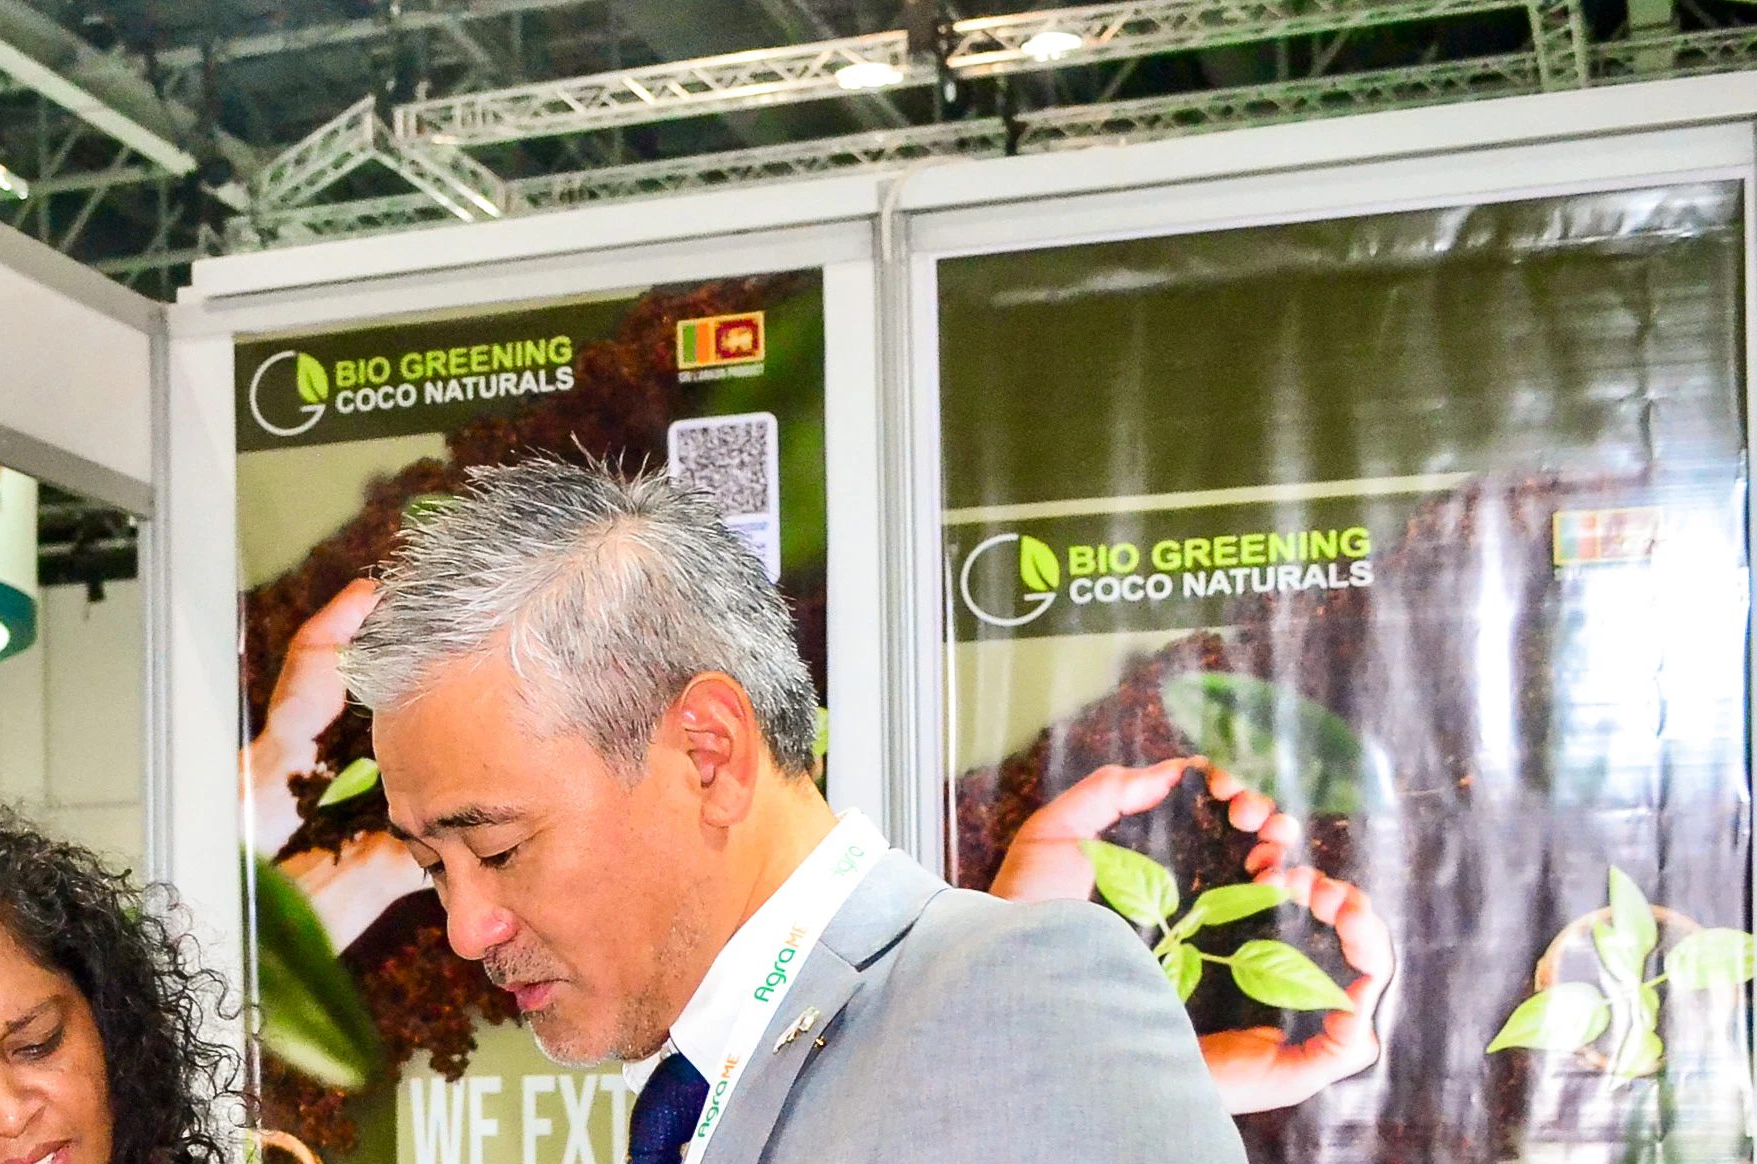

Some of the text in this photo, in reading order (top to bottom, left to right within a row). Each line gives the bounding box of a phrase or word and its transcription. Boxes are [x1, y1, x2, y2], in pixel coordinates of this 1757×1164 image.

[335, 335, 573, 388] BIO GREENING
[335, 366, 575, 415] COCO NATURALS
[1068, 527, 1372, 577] BIO GREENING
[1068, 559, 1374, 605] COCO NATURALS
[754, 922, 809, 1003] AgraME
[698, 1053, 740, 1138] AgraME
